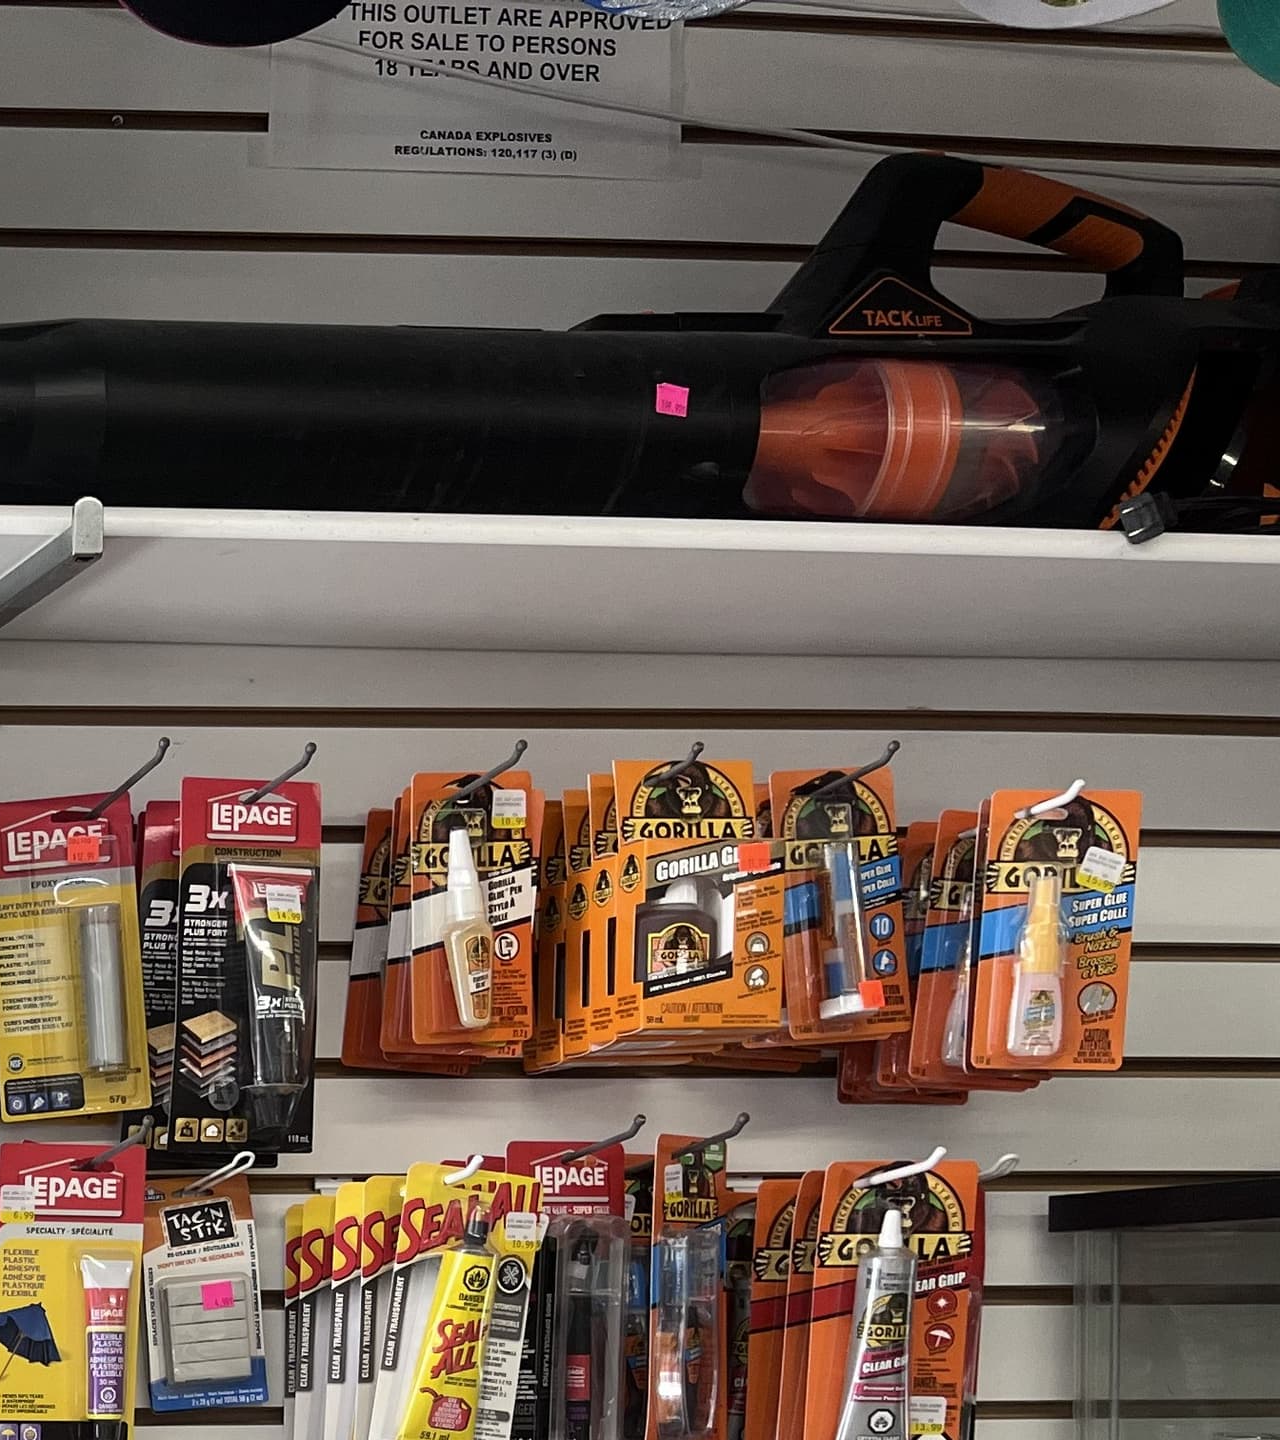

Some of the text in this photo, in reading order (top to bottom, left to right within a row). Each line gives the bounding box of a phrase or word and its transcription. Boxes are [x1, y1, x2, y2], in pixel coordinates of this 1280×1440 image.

[350, 2, 396, 22] THIS
[404, 4, 491, 25] OUTLET
[498, 8, 542, 28] ARE
[359, 31, 616, 57] FOR SALE TO PERSONS
[374, 59, 601, 82] 18 AND OVER
[420, 130, 552, 143] CANADA EXPLOSIVES
[394, 146, 577, 161] REGULATIONS: 120,117 (3) (D)
[211, 802, 292, 832] LEPAGE
[214, 847, 281, 858] CONSTRUCTION
[184, 919, 227, 929] STRONGER
[183, 928, 227, 937] PLUS FORT
